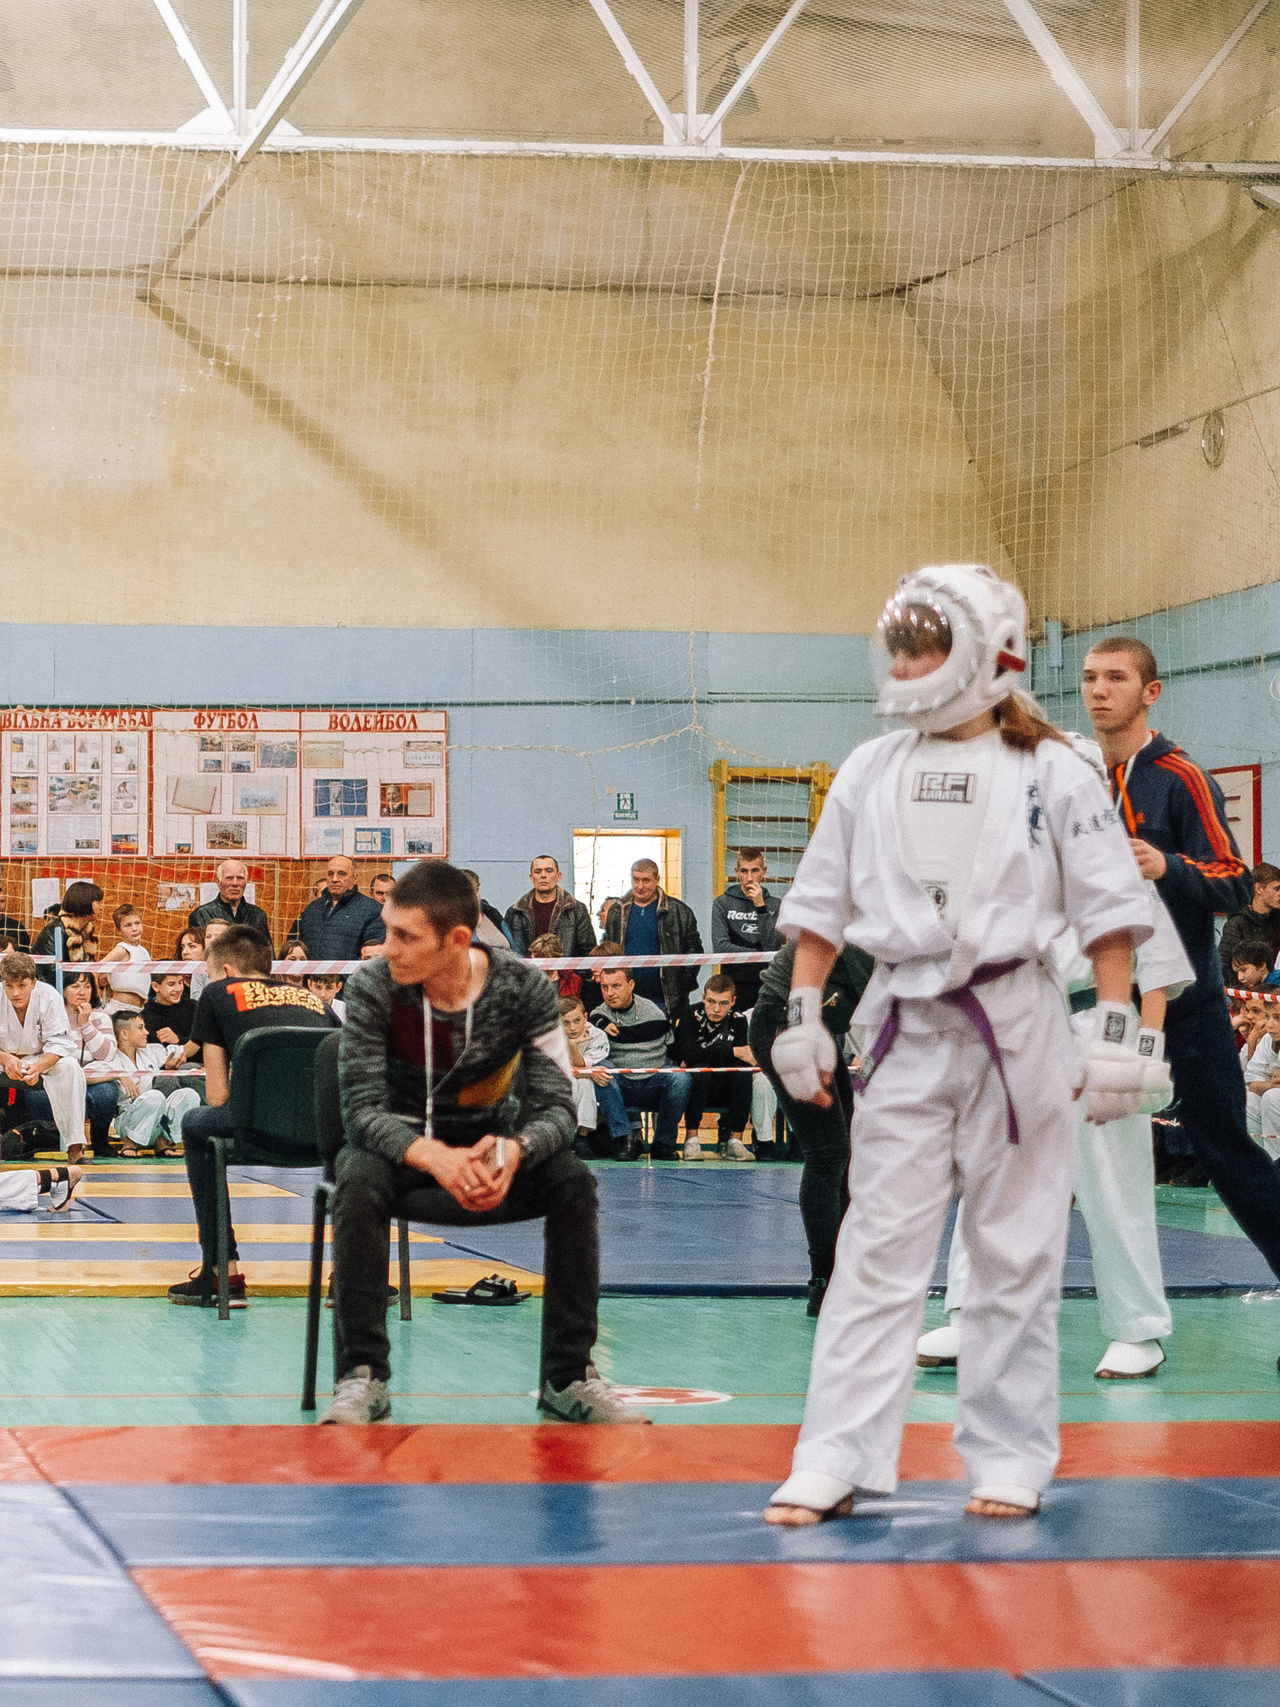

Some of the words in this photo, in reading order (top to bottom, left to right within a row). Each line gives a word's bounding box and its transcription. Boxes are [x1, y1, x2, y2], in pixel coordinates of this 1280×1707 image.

[4, 711, 61, 729] ВІЛЬНА
[193, 712, 259, 730] ФУТБОЛ
[328, 711, 419, 731] ВОЛЕЙБОЛ
[921, 790, 965, 801] KARATE
